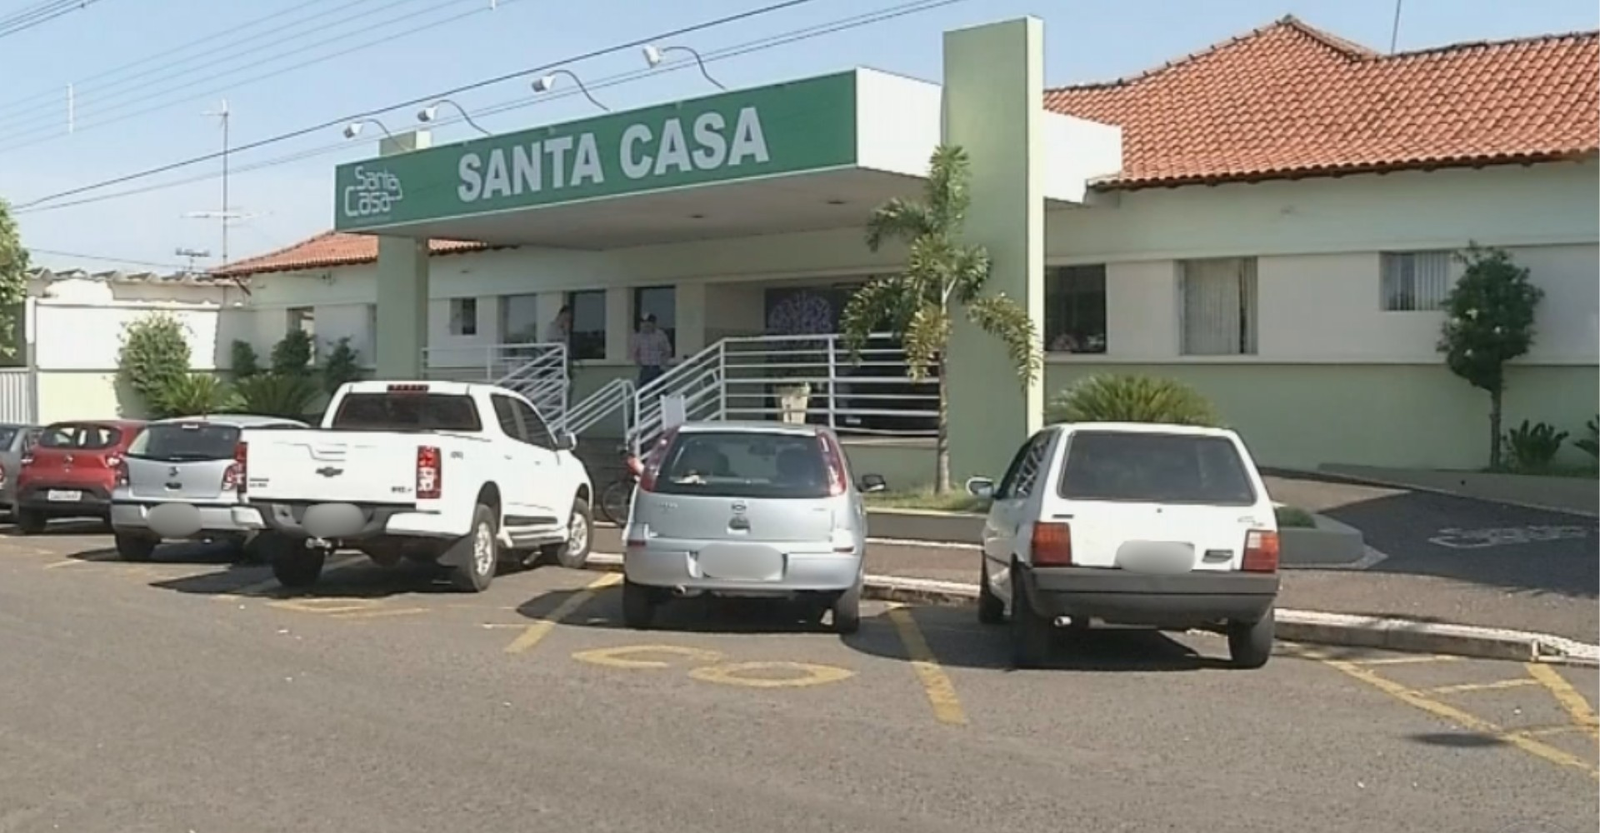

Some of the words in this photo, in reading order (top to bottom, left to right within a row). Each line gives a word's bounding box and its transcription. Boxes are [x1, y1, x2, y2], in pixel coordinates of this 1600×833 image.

[458, 132, 604, 202] SANTA
[620, 107, 769, 179] CASA
[355, 166, 399, 190] Santa
[345, 186, 393, 216] Casa
